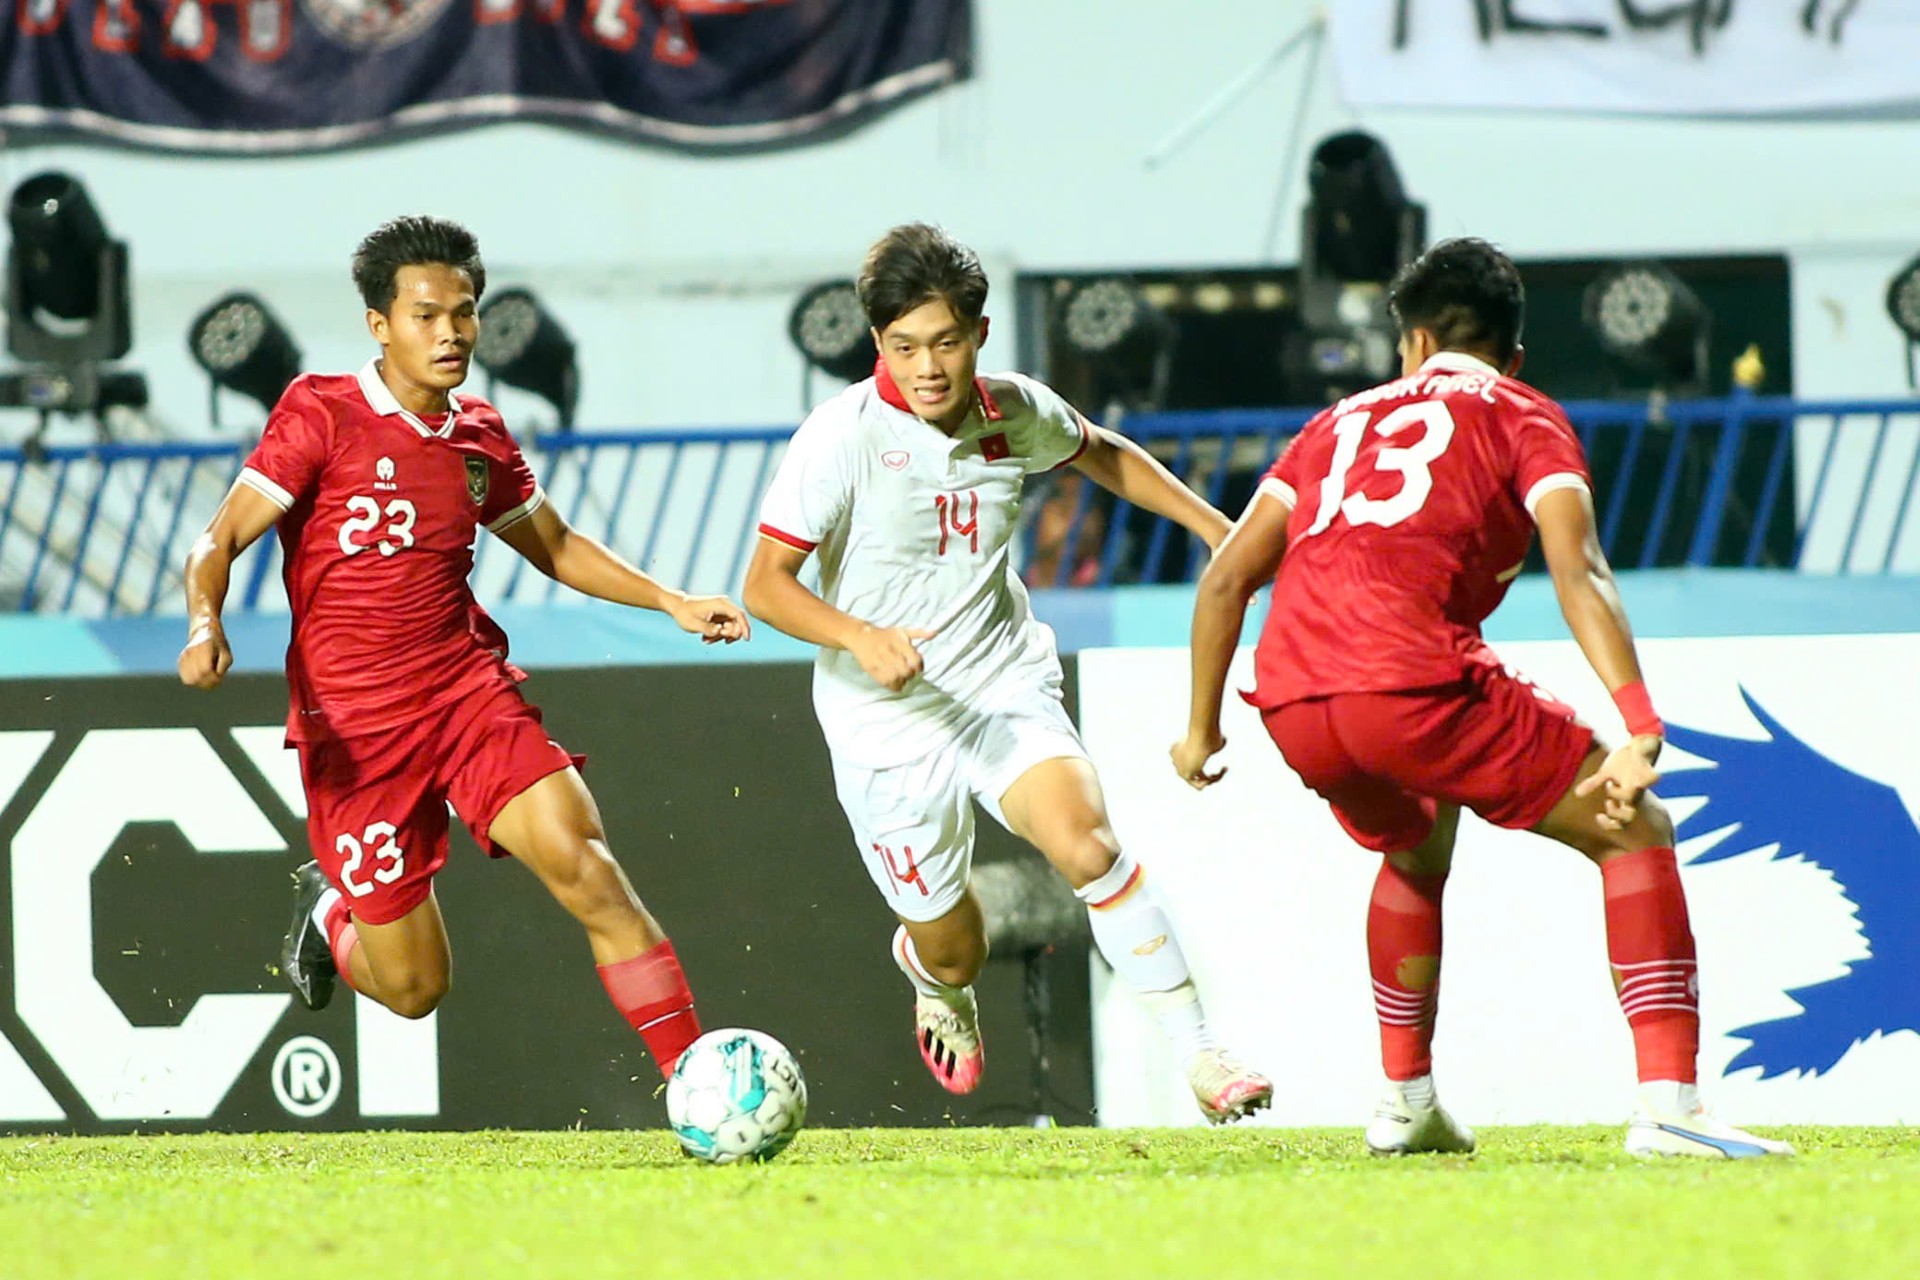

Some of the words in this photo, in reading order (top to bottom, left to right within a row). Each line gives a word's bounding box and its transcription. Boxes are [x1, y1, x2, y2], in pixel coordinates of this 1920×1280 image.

[1308, 399, 1456, 537] 13
[337, 495, 418, 557] 23
[934, 490, 979, 556] 14
[335, 820, 405, 898] 23
[872, 843, 929, 896] 14
